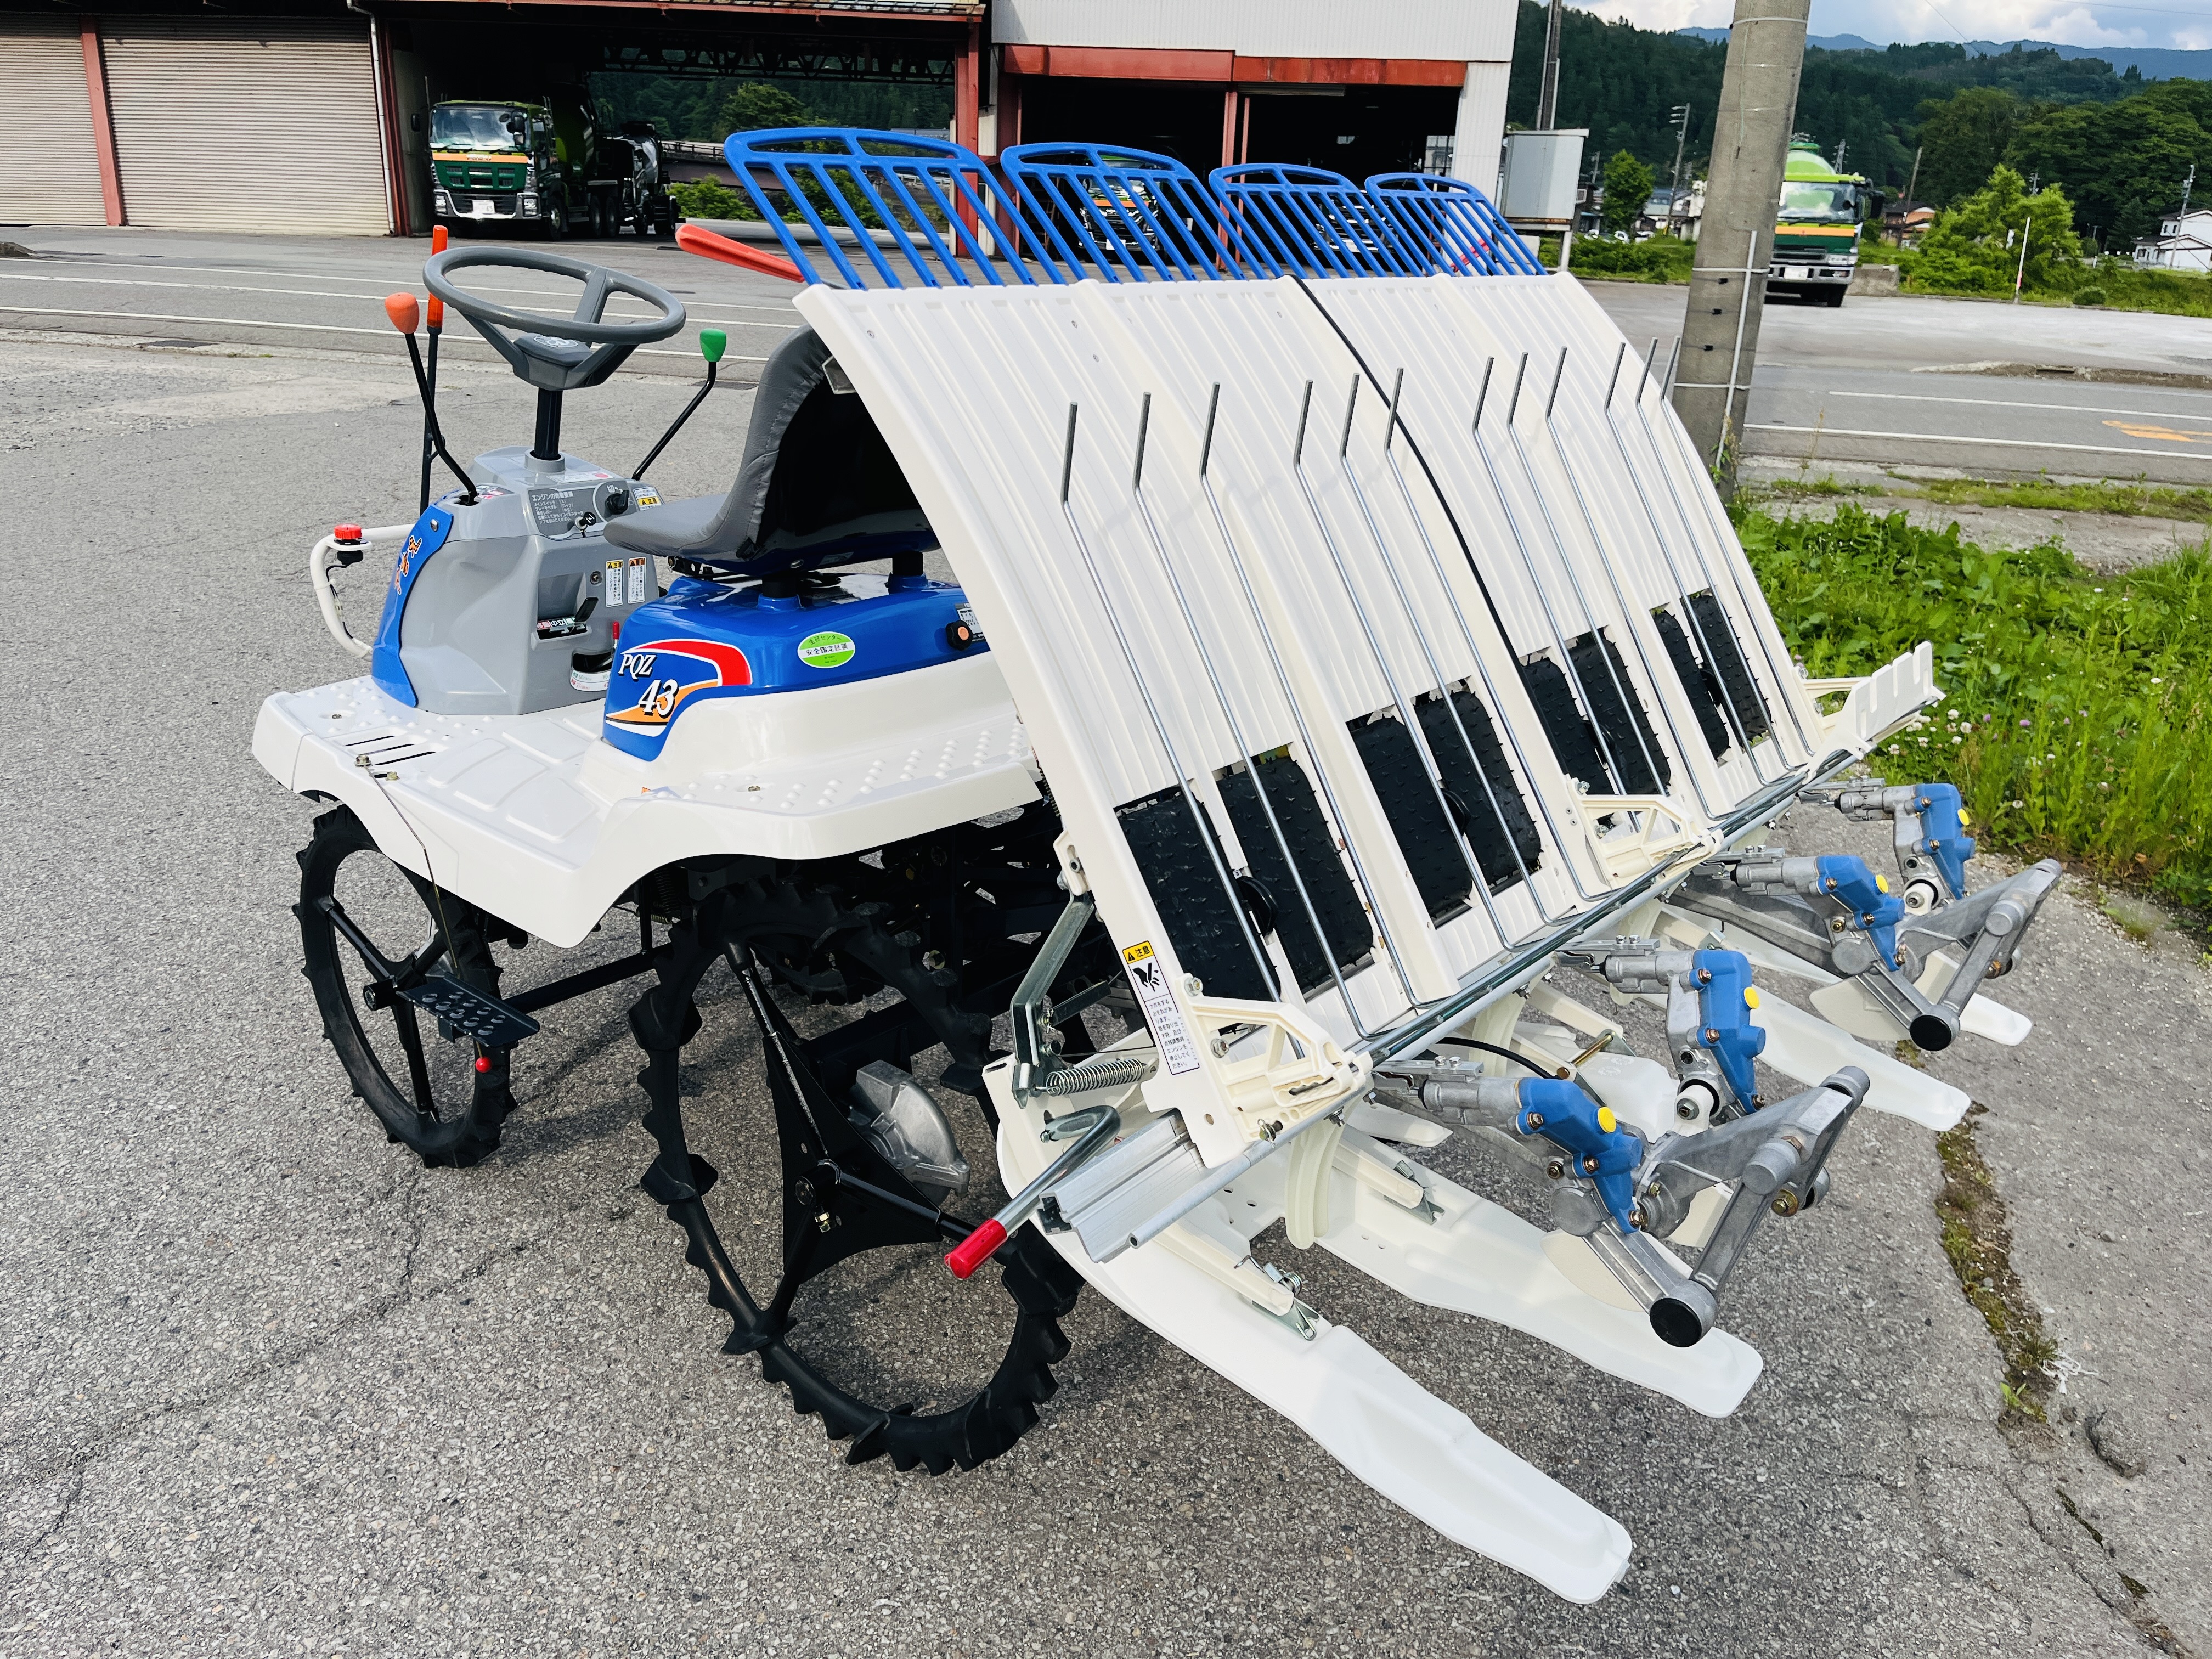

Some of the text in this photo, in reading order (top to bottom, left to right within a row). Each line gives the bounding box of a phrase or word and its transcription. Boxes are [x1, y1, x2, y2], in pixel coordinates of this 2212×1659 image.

[618, 654, 657, 681] PQZ
[638, 679, 679, 718] 43
[1135, 945, 1150, 957] 注意
[1149, 999, 1169, 1009] ケガをする
[1152, 1007, 1172, 1017] おそれがあ
[1167, 1044, 1187, 1054] エンジンを
[1169, 1051, 1190, 1062] 停止してく
